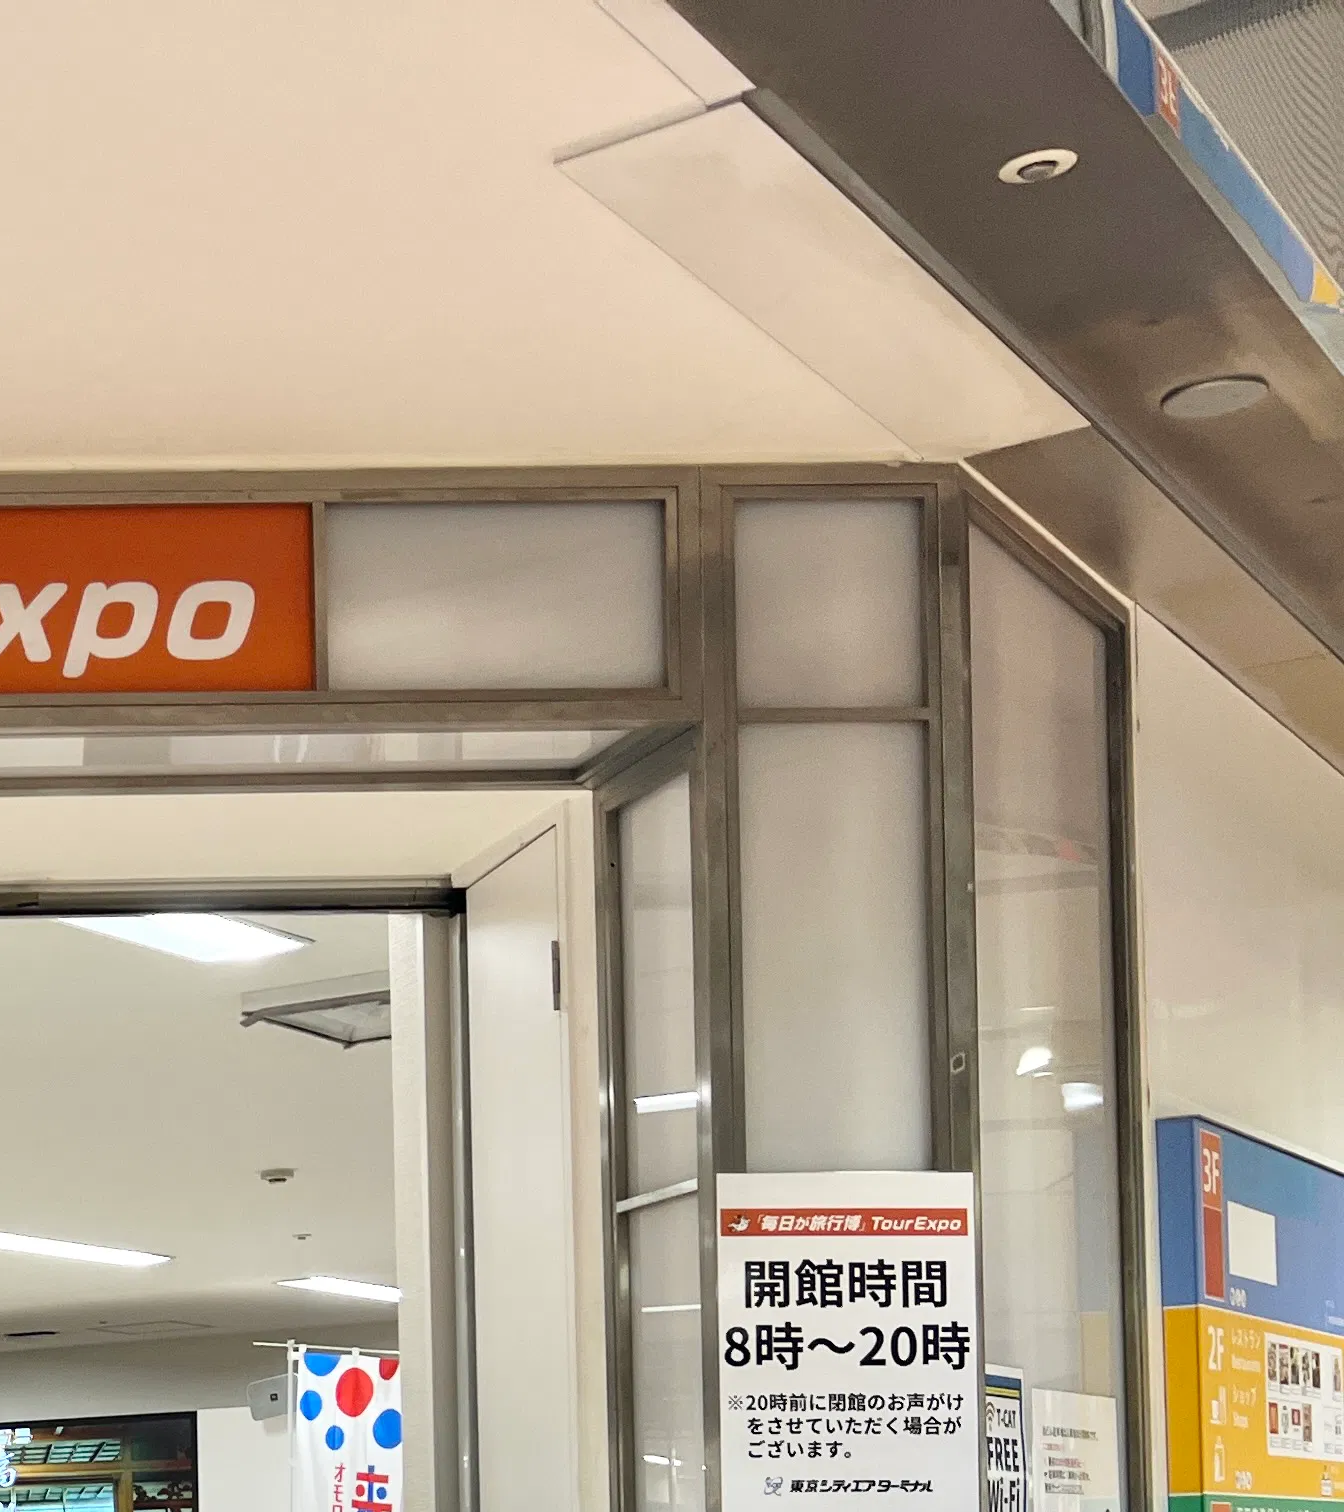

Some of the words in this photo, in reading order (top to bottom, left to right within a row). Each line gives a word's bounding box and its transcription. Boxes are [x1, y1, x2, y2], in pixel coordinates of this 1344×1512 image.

[1202, 1147, 1220, 1195] 3F
[744, 1258, 948, 1309] 開館時間
[1207, 1324, 1225, 1372] 2F
[728, 1393, 964, 1412] ※20時前に閉館のお声がけ
[747, 1417, 962, 1435] をさせていただく場合が
[996, 1407, 1017, 1429] T-CAT
[748, 1440, 852, 1459] ございます。
[986, 1436, 1020, 1473] FREE
